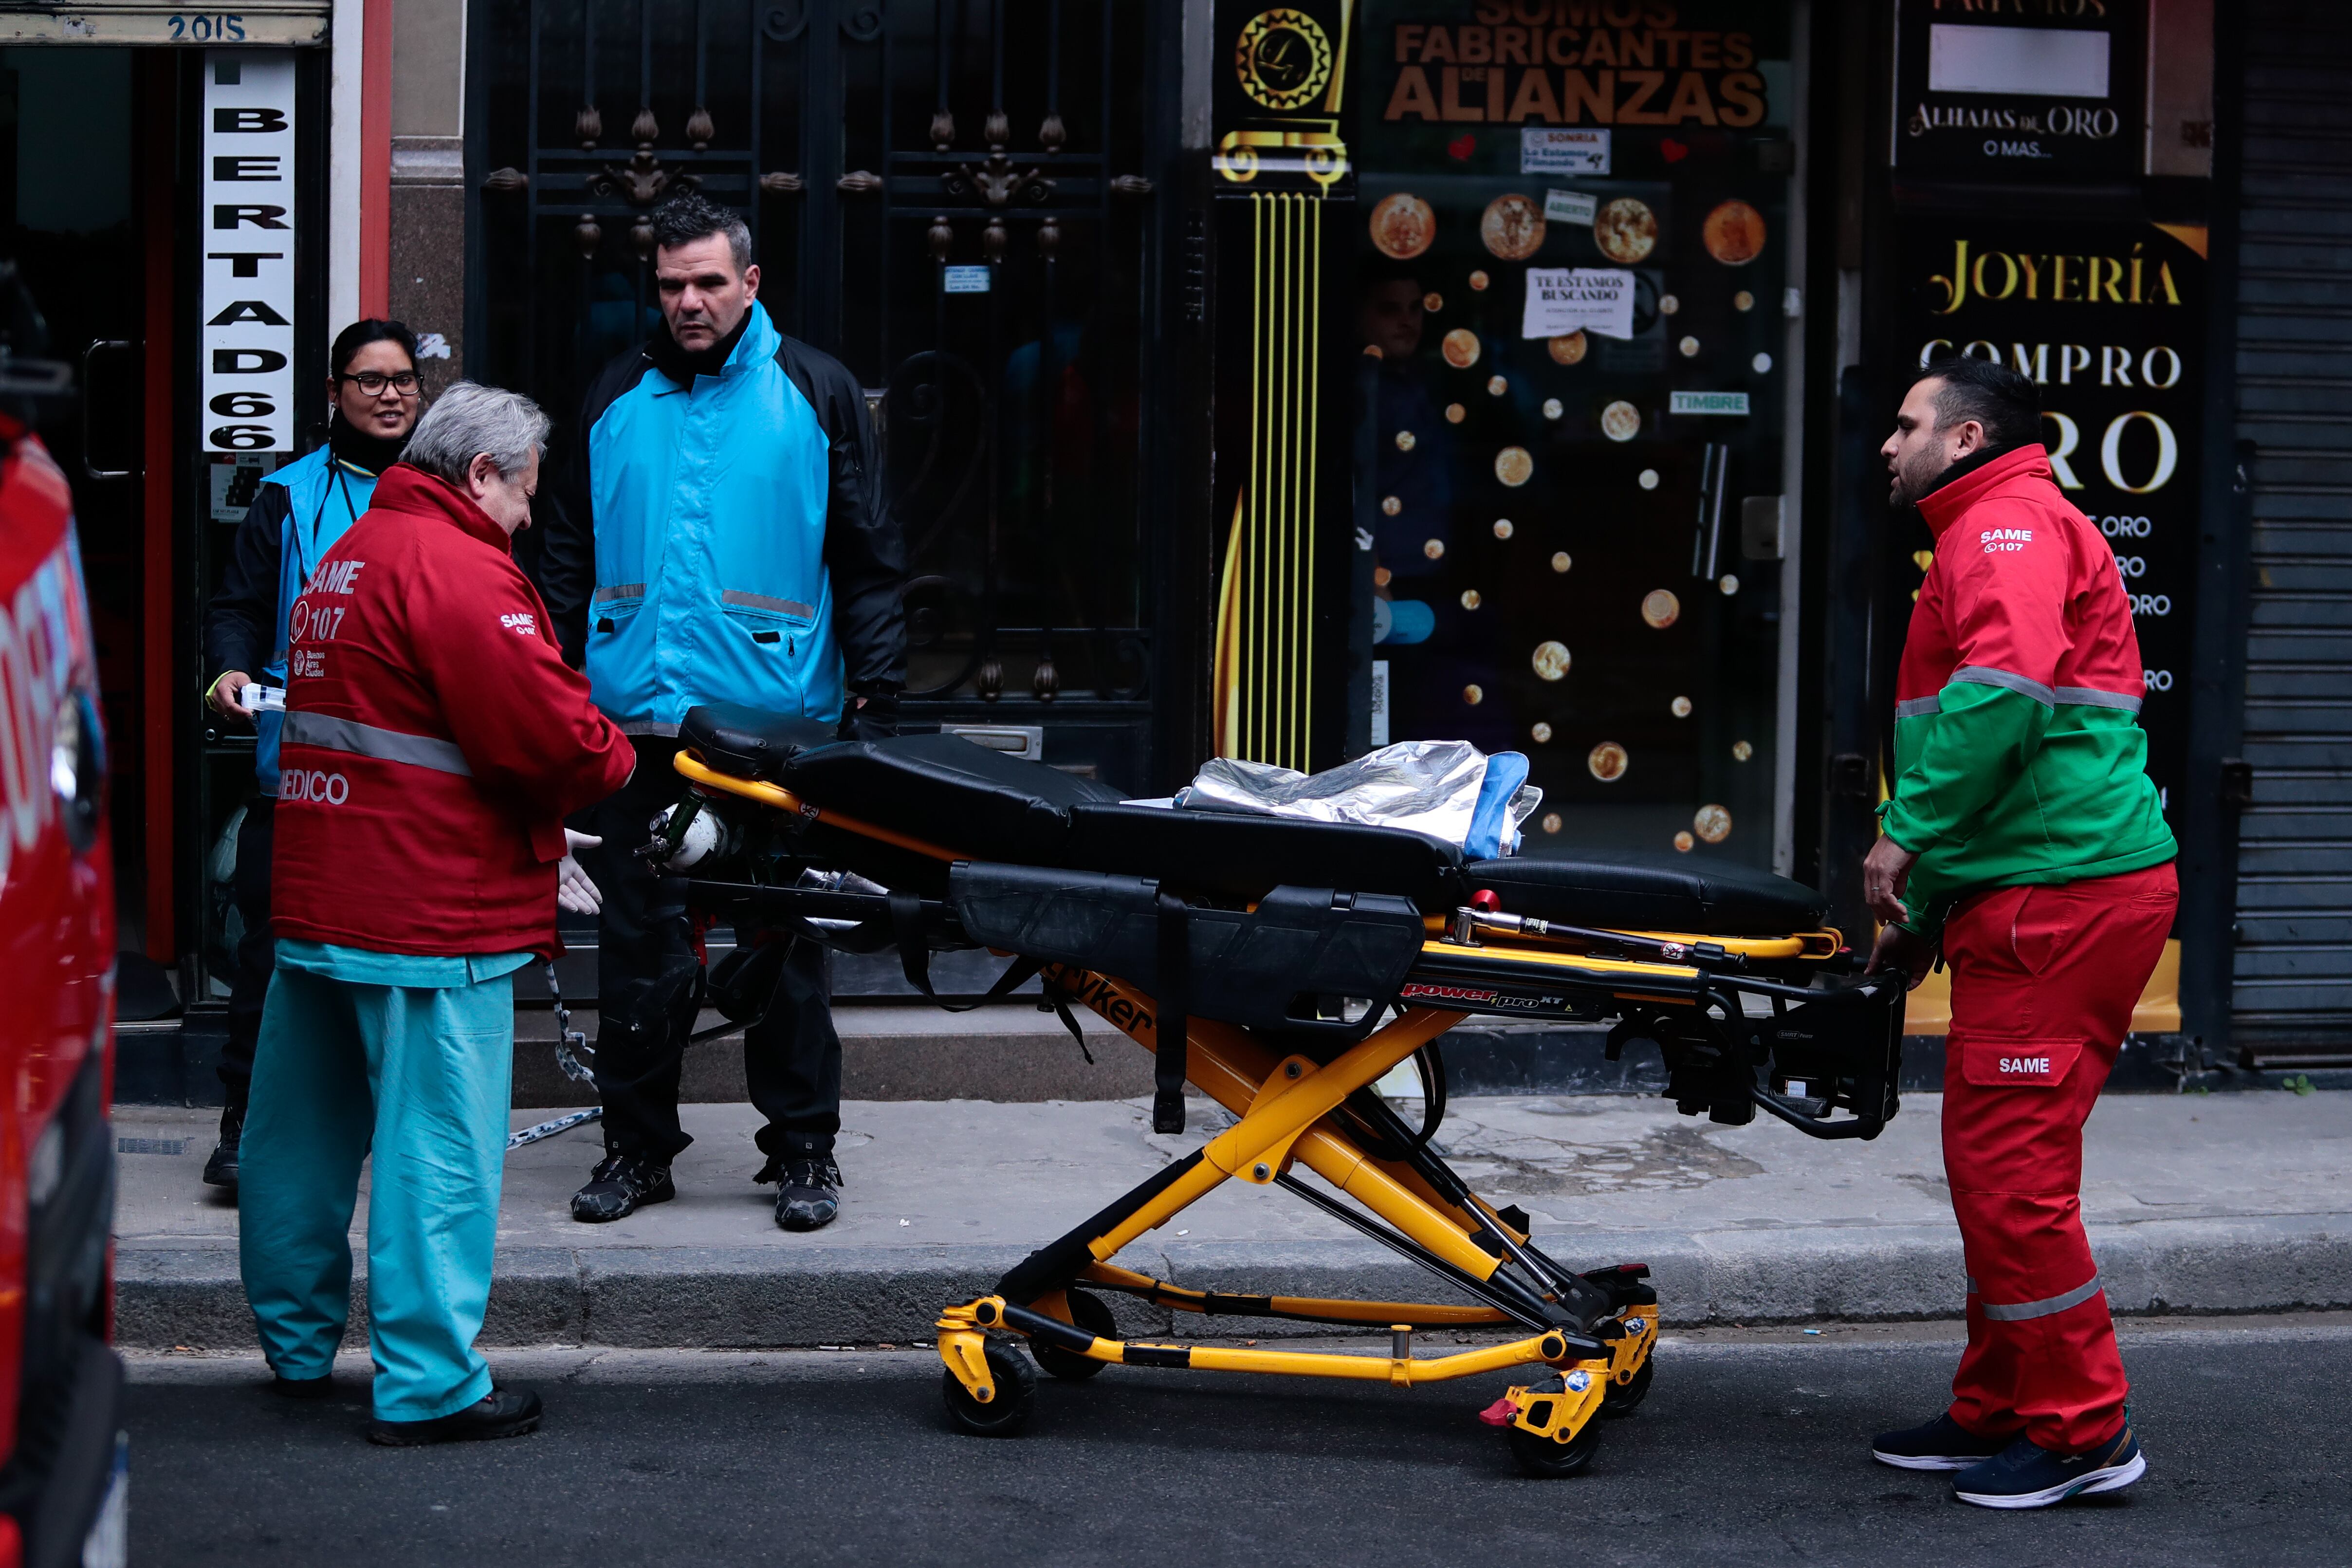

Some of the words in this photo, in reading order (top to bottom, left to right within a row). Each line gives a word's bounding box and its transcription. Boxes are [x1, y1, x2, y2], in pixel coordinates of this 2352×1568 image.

[1476, 0, 1677, 27] SOMOS
[168, 15, 245, 42] 2015
[1395, 25, 1754, 70] FABRICANTES
[1462, 66, 1487, 83] DE
[1384, 67, 1766, 128] ALIANZAS
[1908, 102, 2016, 137] ALHAJAS
[2047, 106, 2119, 140] ORO
[1983, 140, 1998, 156] O
[1536, 276, 1553, 287] TE
[1557, 276, 1623, 288] ESTAMOS
[1928, 240, 2182, 314] JOYERÍA
[1542, 290, 1618, 301] BUSCANDO
[1674, 393, 1744, 410] TIMBRE
[2041, 411, 2178, 494] RO
[1980, 528, 2032, 543] SAME
[2100, 516, 2151, 538] ORO
[1998, 542, 2024, 551] 107
[304, 560, 365, 596] SAME
[2115, 556, 2146, 578] RO
[311, 607, 345, 640] 107
[500, 613, 535, 628] SAME
[306, 660, 319, 669] Aires
[307, 650, 325, 660] Buenos
[305, 668, 325, 677] Ciudad
[2144, 670, 2173, 692] RO
[1400, 983, 1498, 1001] power
[1495, 996, 1539, 1008] pro
[1540, 996, 1564, 1004] XT
[1999, 1057, 2049, 1073] SAME
